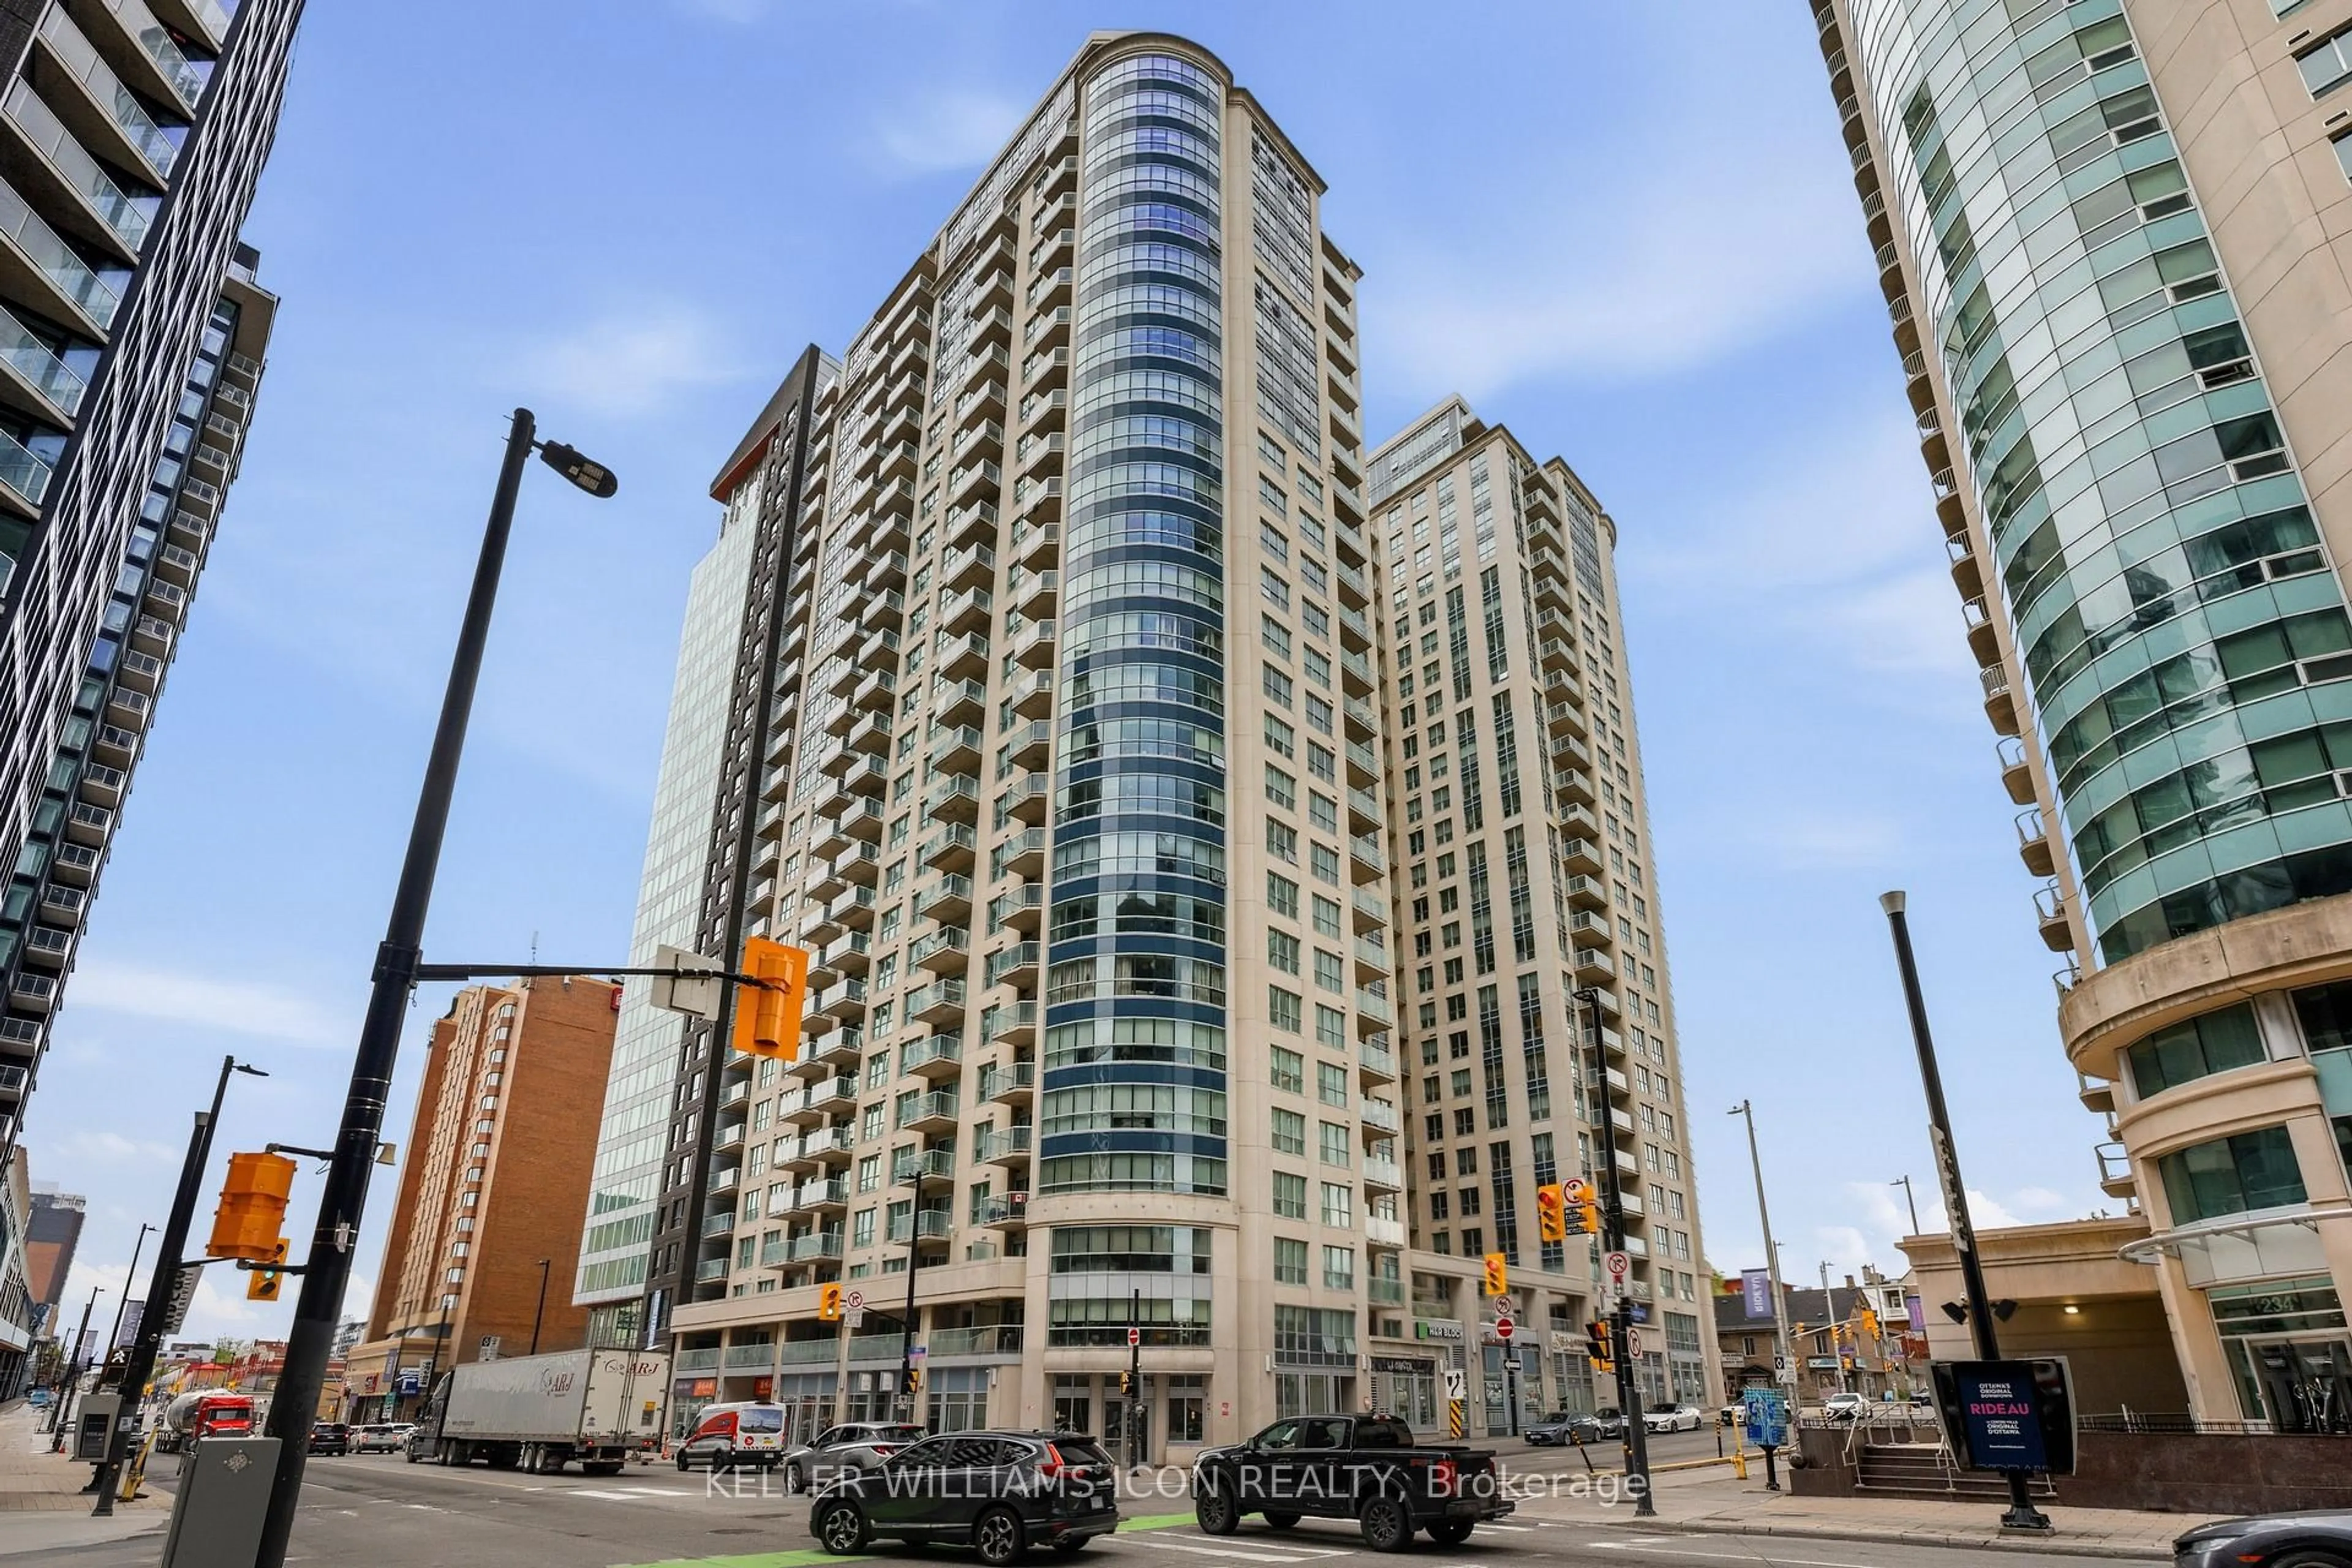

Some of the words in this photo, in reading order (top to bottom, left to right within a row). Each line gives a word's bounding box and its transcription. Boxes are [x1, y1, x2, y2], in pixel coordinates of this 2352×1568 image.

[2261, 1295, 2294, 1313] 234
[627, 1362, 659, 1374] ARJ
[551, 1373, 575, 1392] ARJ
[1970, 1403, 2029, 1415] RIDEAU
